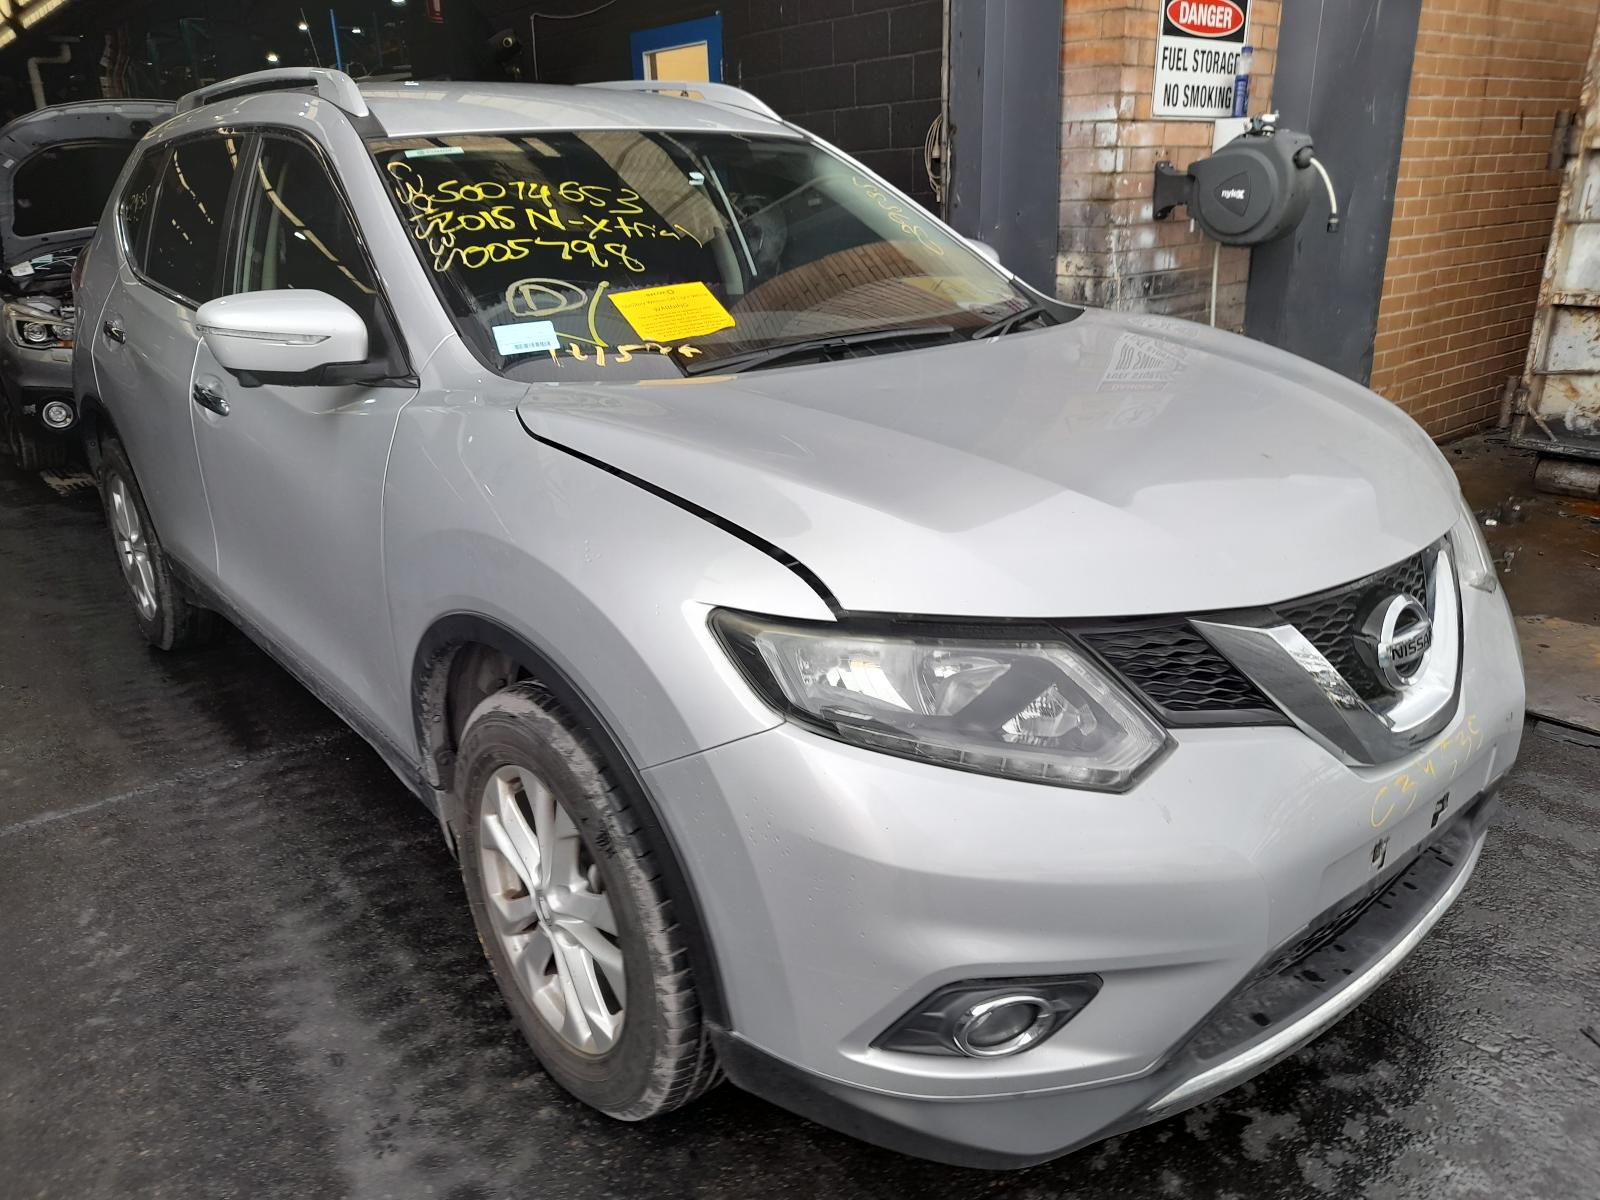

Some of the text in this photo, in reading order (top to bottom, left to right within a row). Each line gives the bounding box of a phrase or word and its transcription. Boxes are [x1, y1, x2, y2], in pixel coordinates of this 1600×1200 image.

[1179, 1, 1232, 29] DANGER
[1161, 46, 1187, 71] FUEL
[1163, 83, 1232, 109] NO SMOKING
